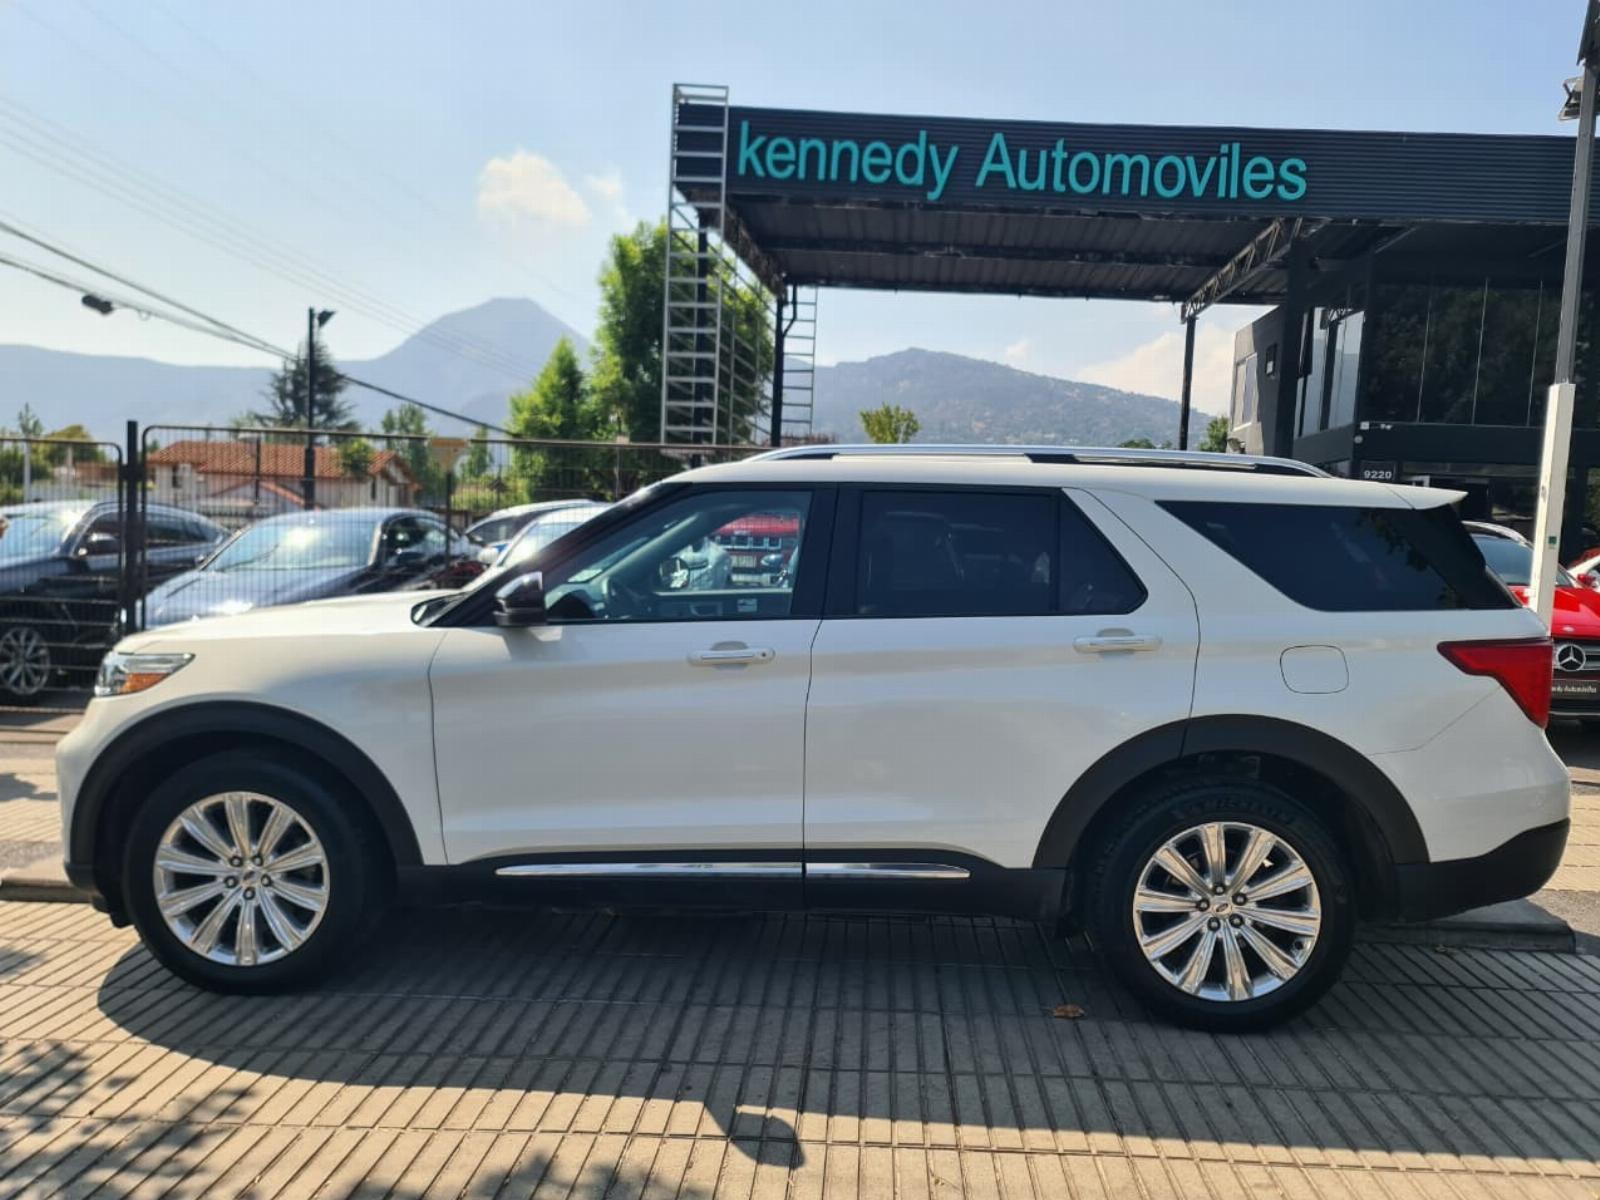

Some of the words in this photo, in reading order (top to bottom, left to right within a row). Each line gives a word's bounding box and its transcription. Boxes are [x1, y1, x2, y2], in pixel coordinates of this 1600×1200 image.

[738, 120, 959, 200] kennedy
[975, 132, 1307, 200] Automoviles
[1363, 470, 1393, 479] 9220
